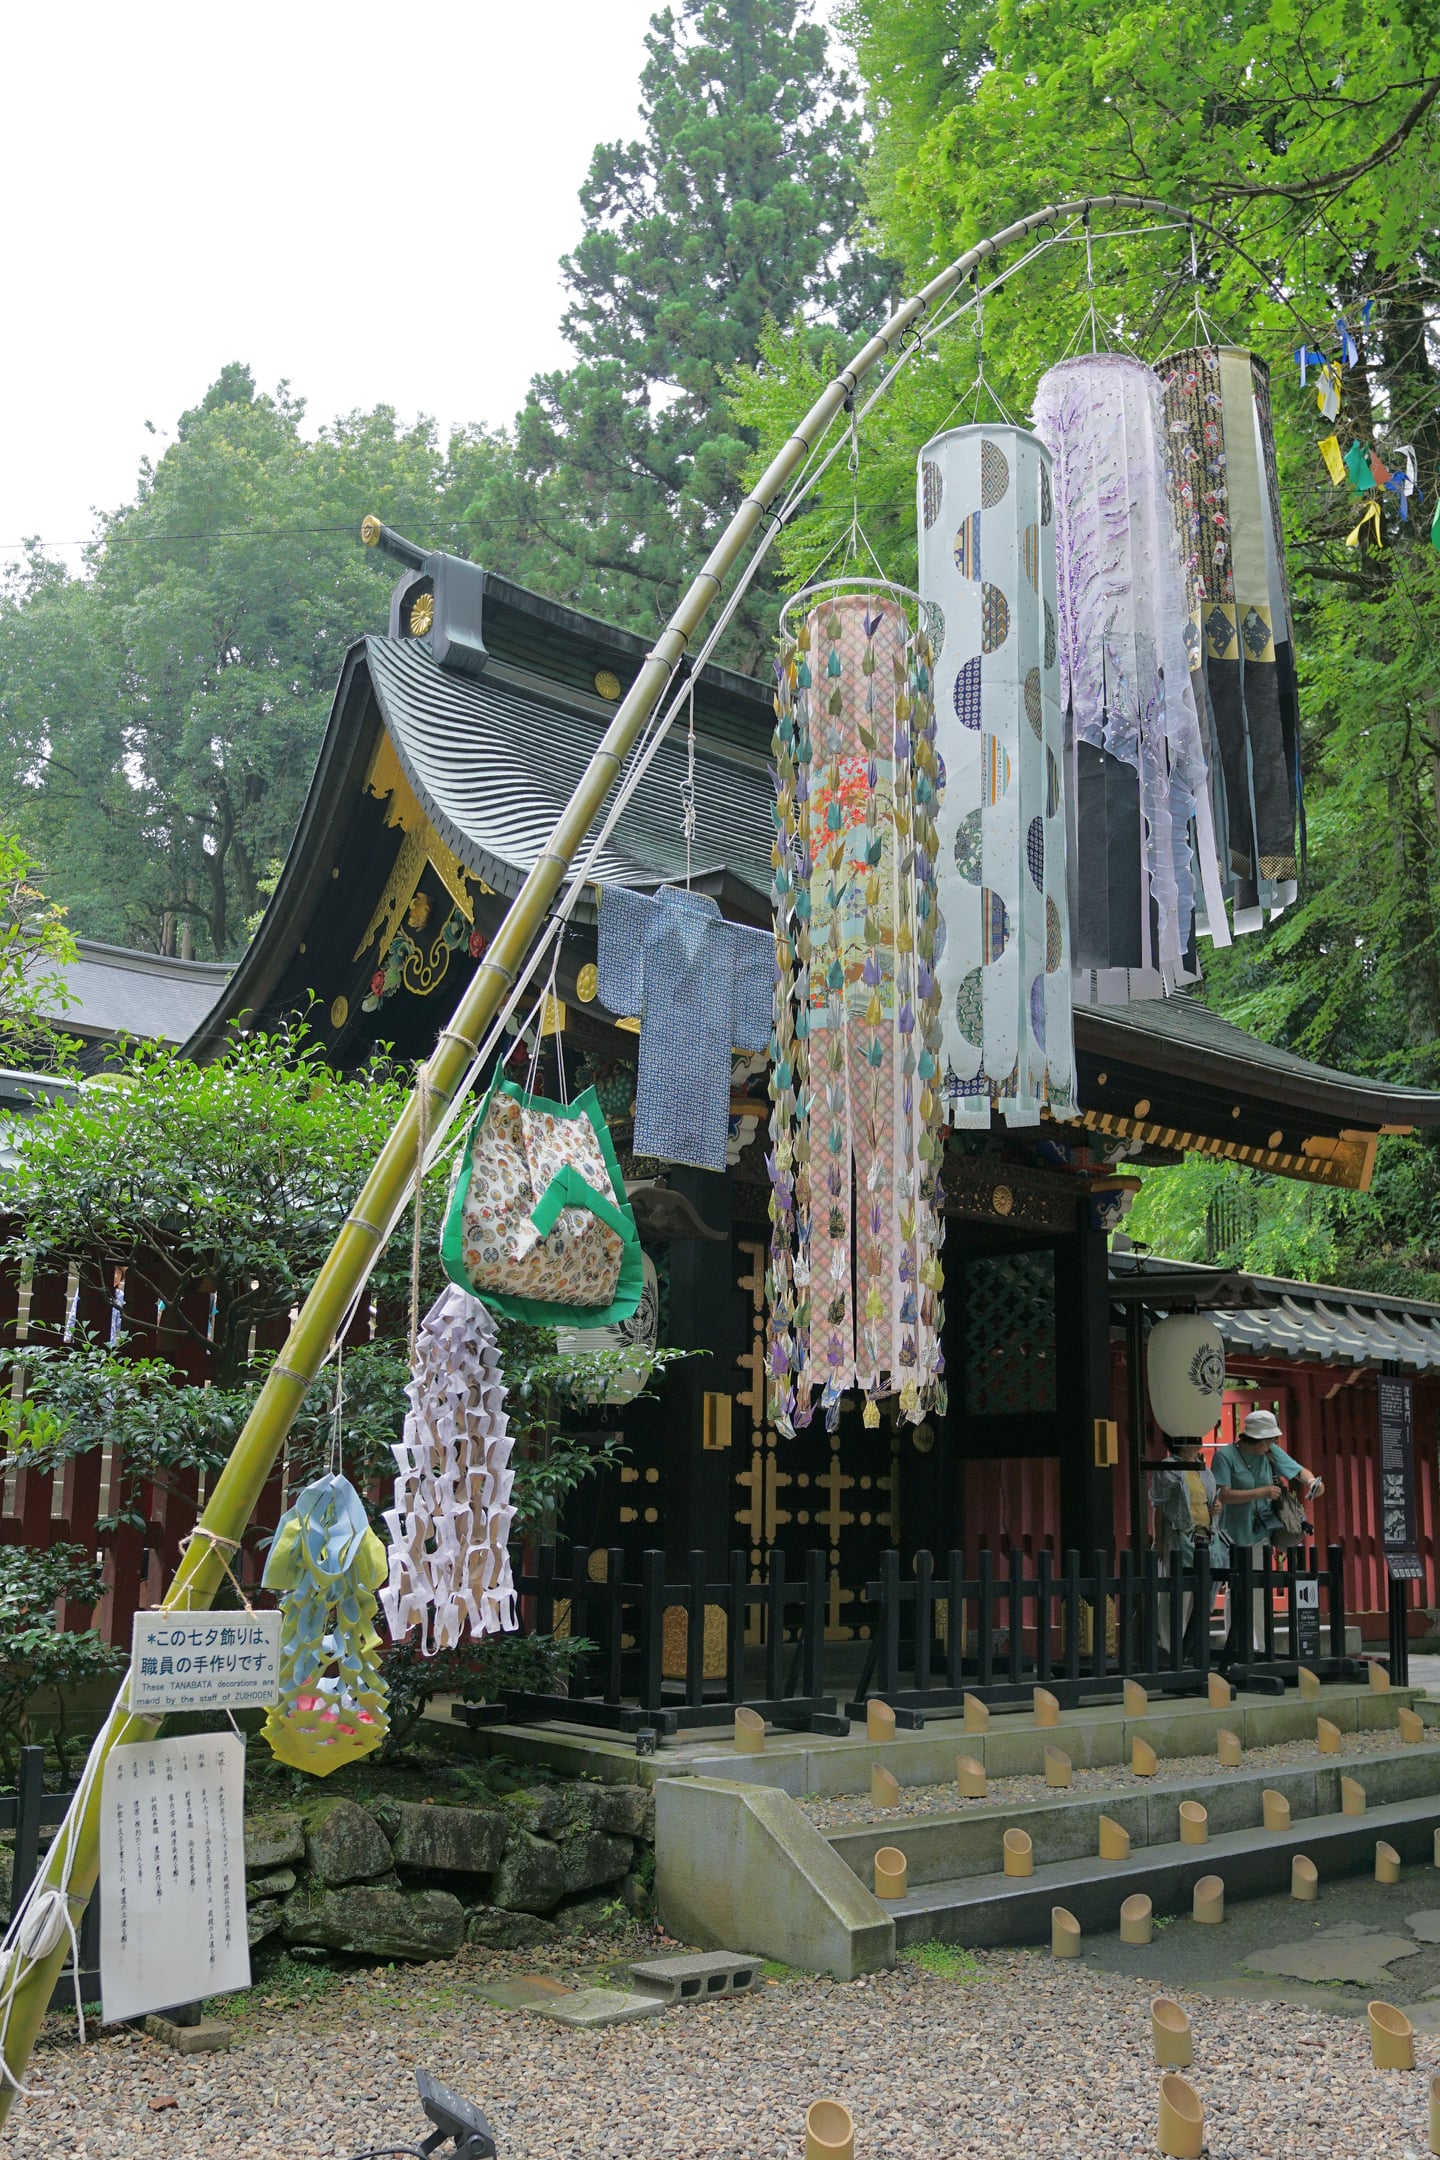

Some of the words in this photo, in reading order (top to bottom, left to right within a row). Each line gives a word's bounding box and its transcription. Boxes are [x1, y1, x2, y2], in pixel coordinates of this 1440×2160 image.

[141, 1653, 274, 1676] 職員の手作りです。
[142, 1683, 165, 1692] These
[171, 1680, 213, 1690] TANABATA
[218, 1679, 258, 1689] decorations
[166, 1696, 176, 1705] by
[181, 1695, 194, 1703] the
[200, 1693, 218, 1702] staff
[223, 1693, 231, 1701] of
[235, 1692, 273, 1701] ZUIHODEN
